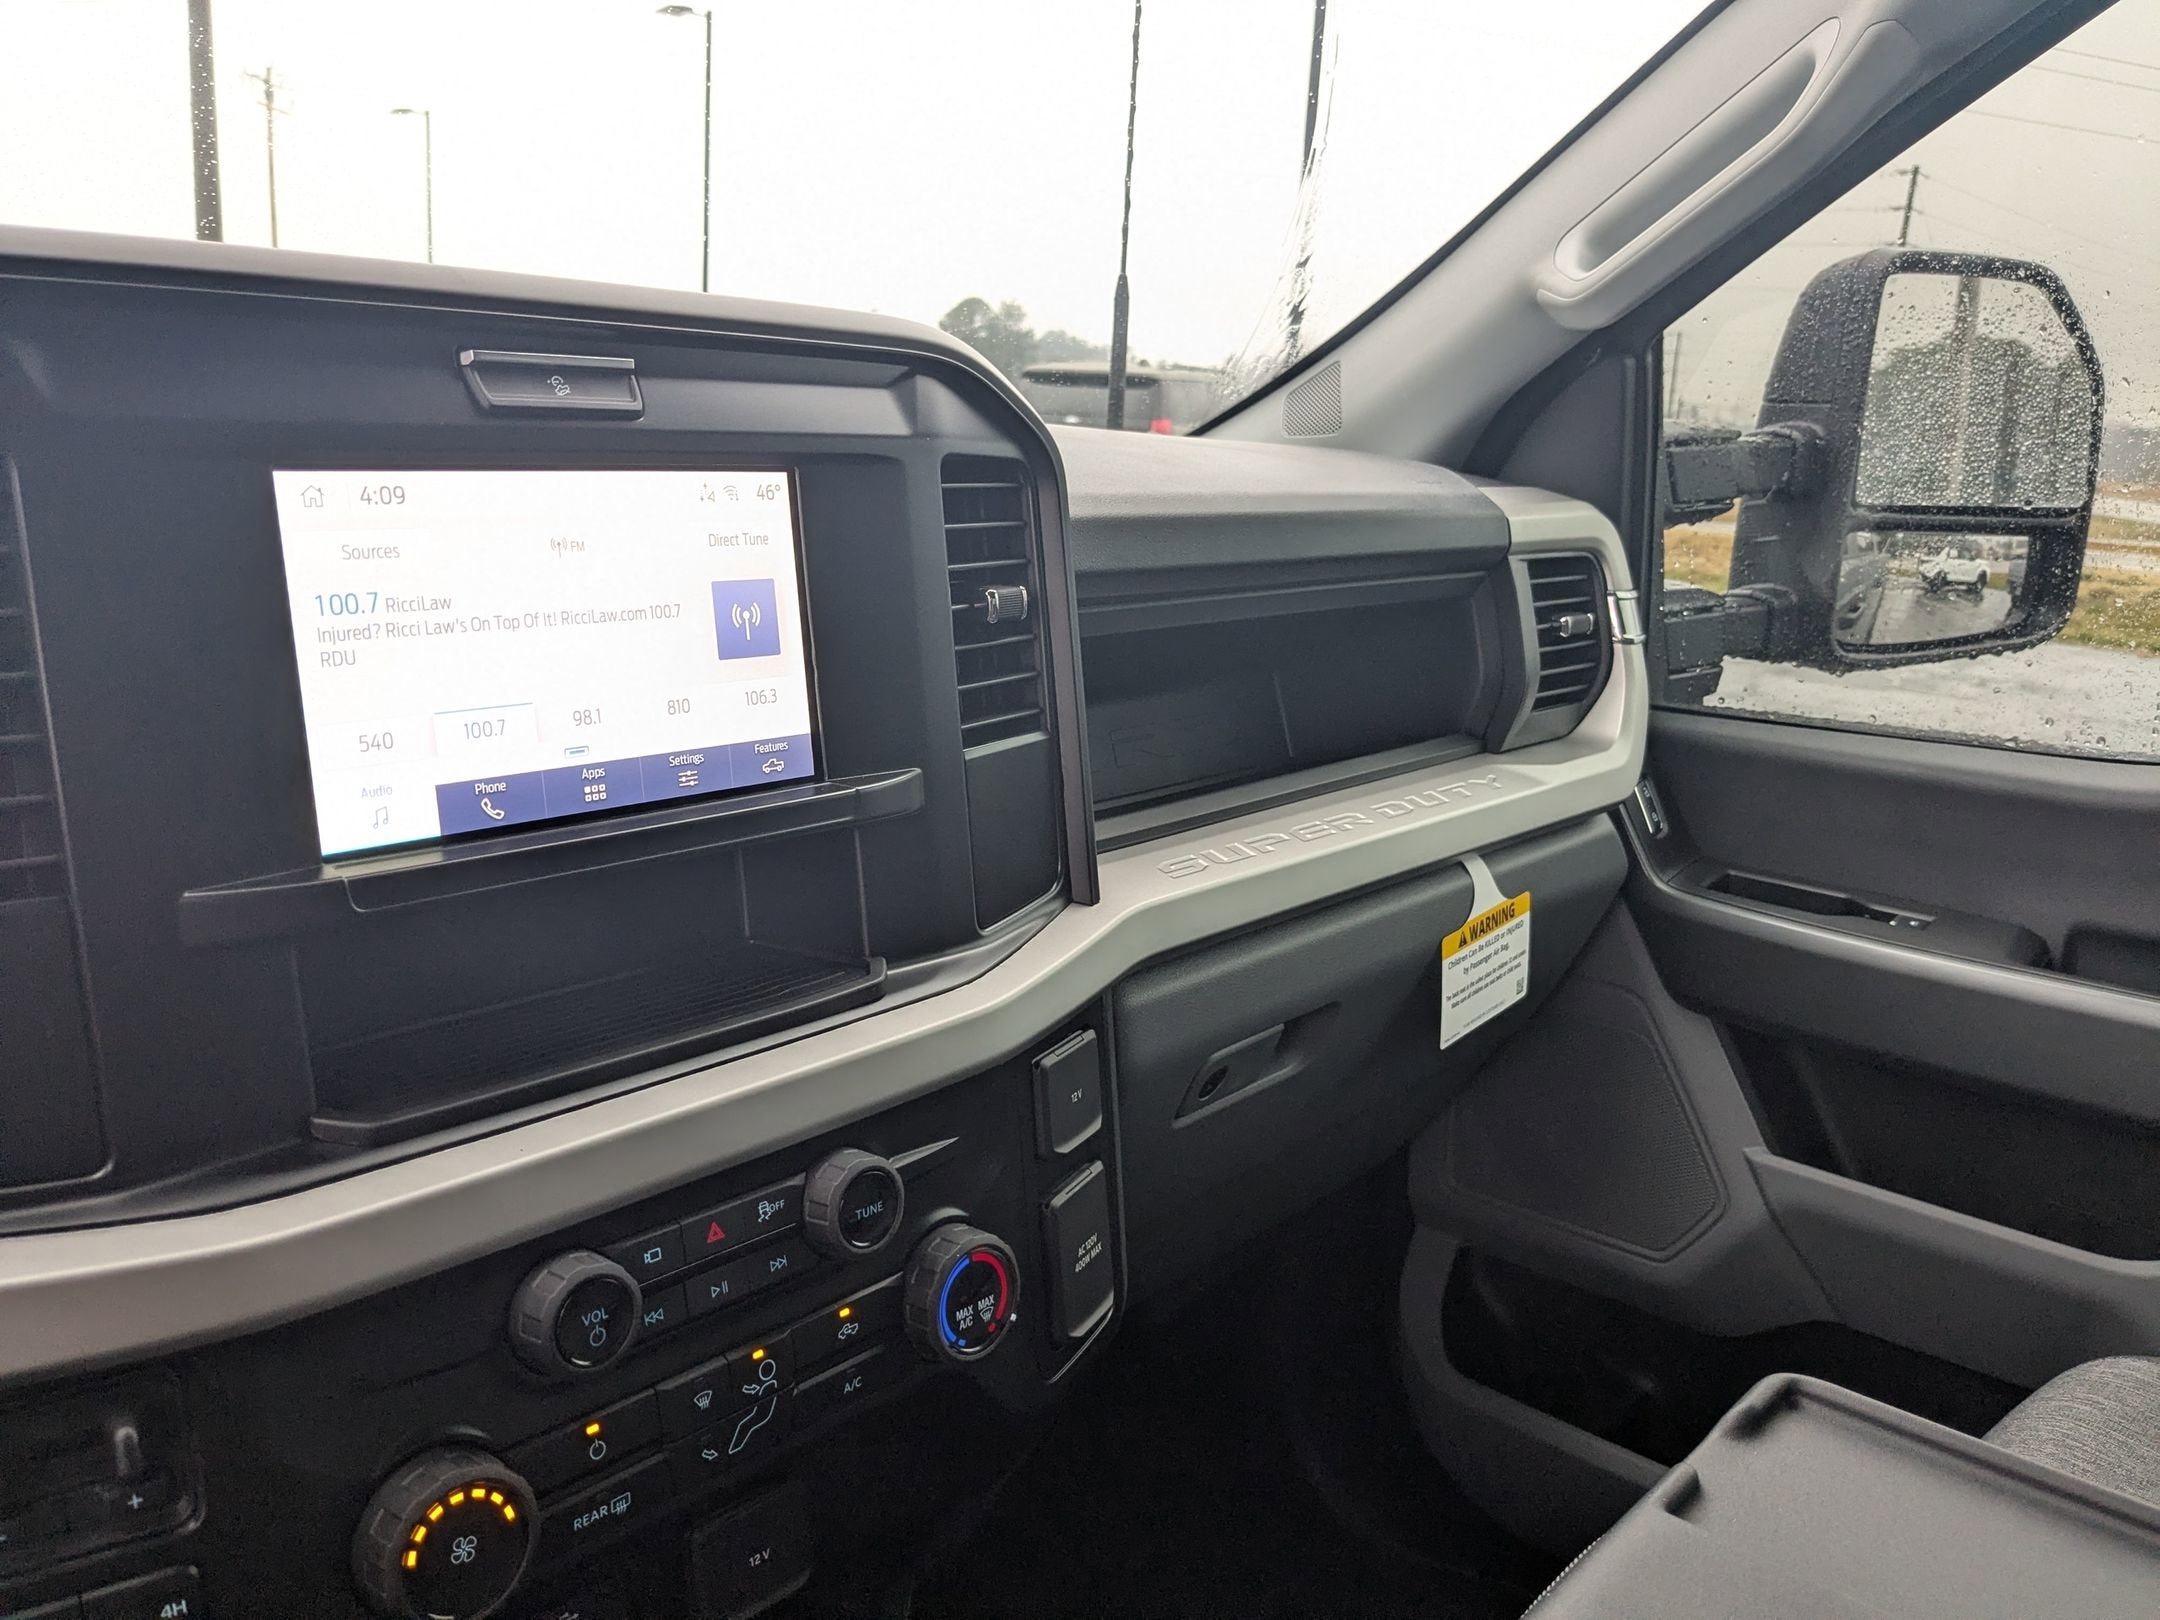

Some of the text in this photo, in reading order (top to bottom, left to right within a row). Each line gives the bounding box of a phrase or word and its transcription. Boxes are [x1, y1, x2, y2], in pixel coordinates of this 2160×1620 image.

[360, 485, 406, 505] 4:09
[570, 540, 585, 552] FM
[708, 532, 769, 548] Direct Tune
[341, 544, 401, 561] Sources
[315, 591, 452, 617] 100.7 RicciLaw
[317, 603, 681, 646] Injured? Ricci Law's On Top Of It! RicciLaw.com 100.7
[320, 649, 356, 669] RDU
[359, 688, 778, 753] 540 100.7 98.1 810 106.3
[361, 740, 789, 800] Audio Phone Apps Settings Features
[1156, 773, 1503, 880] SUPER DUTY
[1468, 902, 1516, 943] WARNING
[769, 1199, 785, 1213] OFF
[855, 1201, 886, 1221] TUNE
[977, 1294, 996, 1311] MAX
[581, 1307, 609, 1327] VOL
[956, 1304, 974, 1322] MAX
[959, 1315, 974, 1331] A/C
[843, 1376, 863, 1394] A/C
[573, 1504, 609, 1531] REAR
[160, 1599, 188, 1618] 4H
